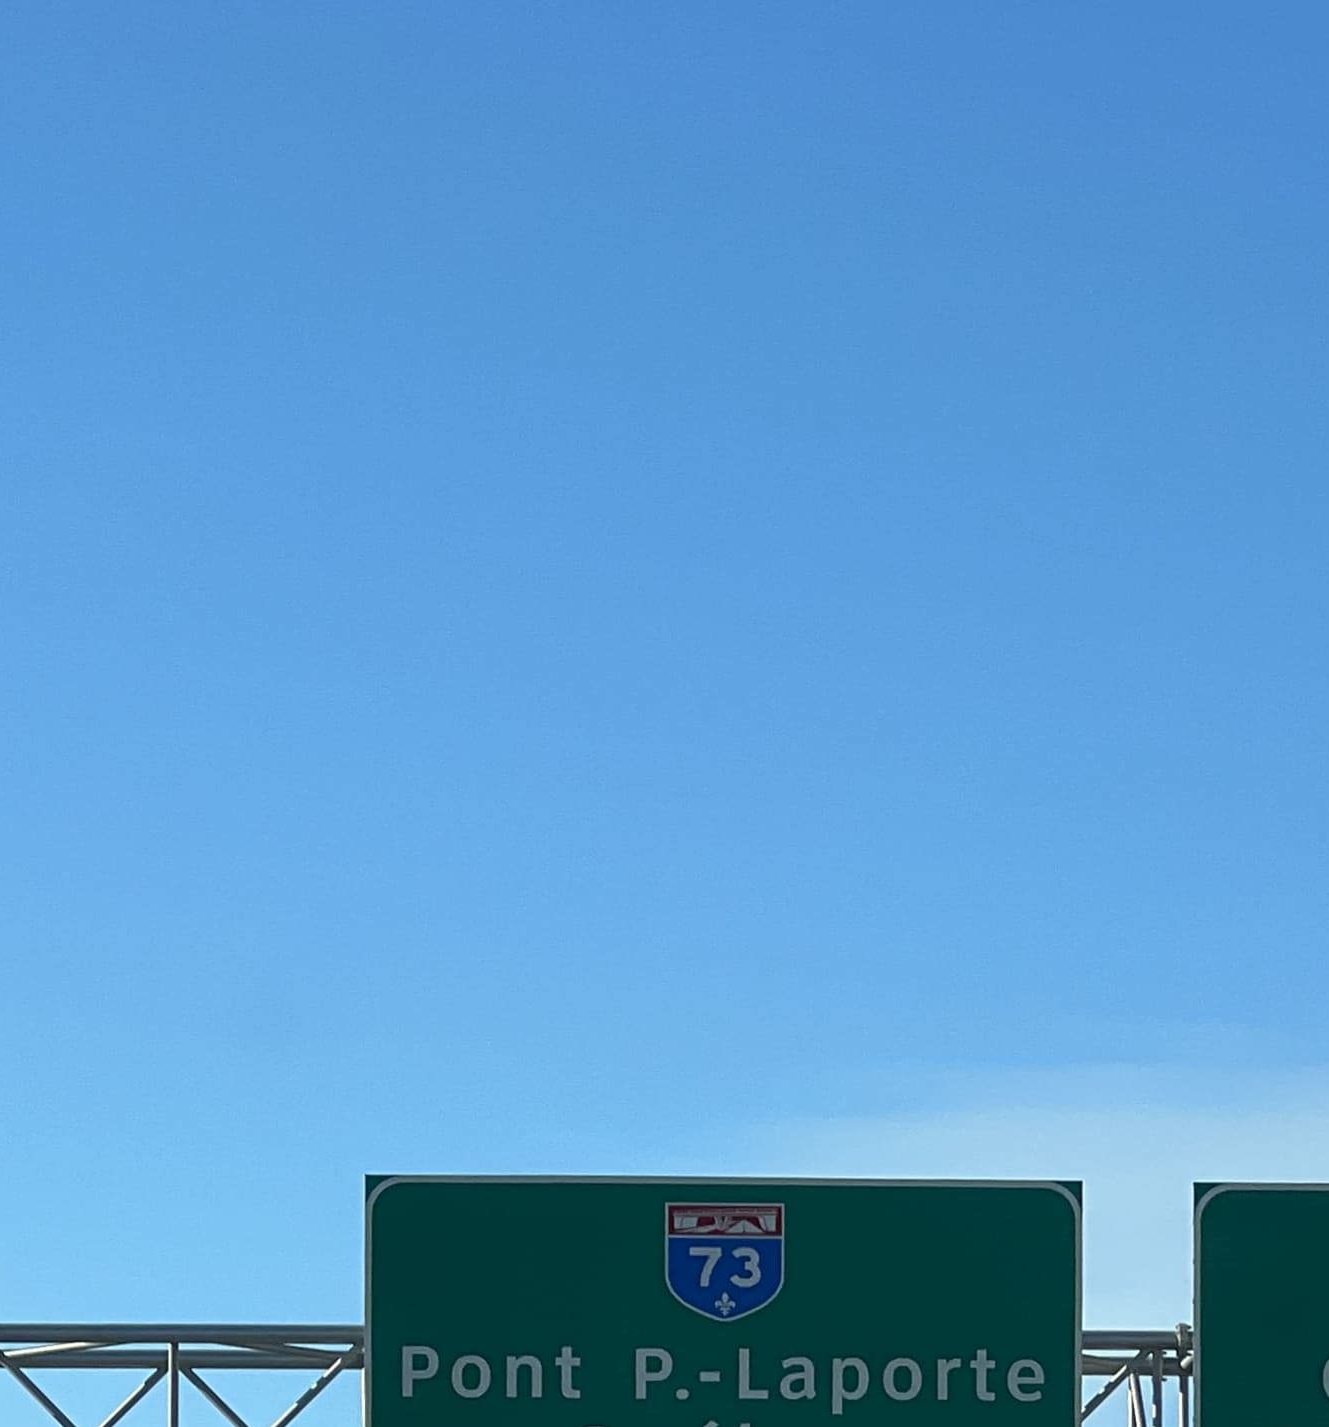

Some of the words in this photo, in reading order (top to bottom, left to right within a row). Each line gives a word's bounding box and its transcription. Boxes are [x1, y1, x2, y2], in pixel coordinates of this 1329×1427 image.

[689, 1247, 761, 1287] 73
[402, 1346, 581, 1399] Pont
[635, 1348, 1045, 1415] P.-Laporte
